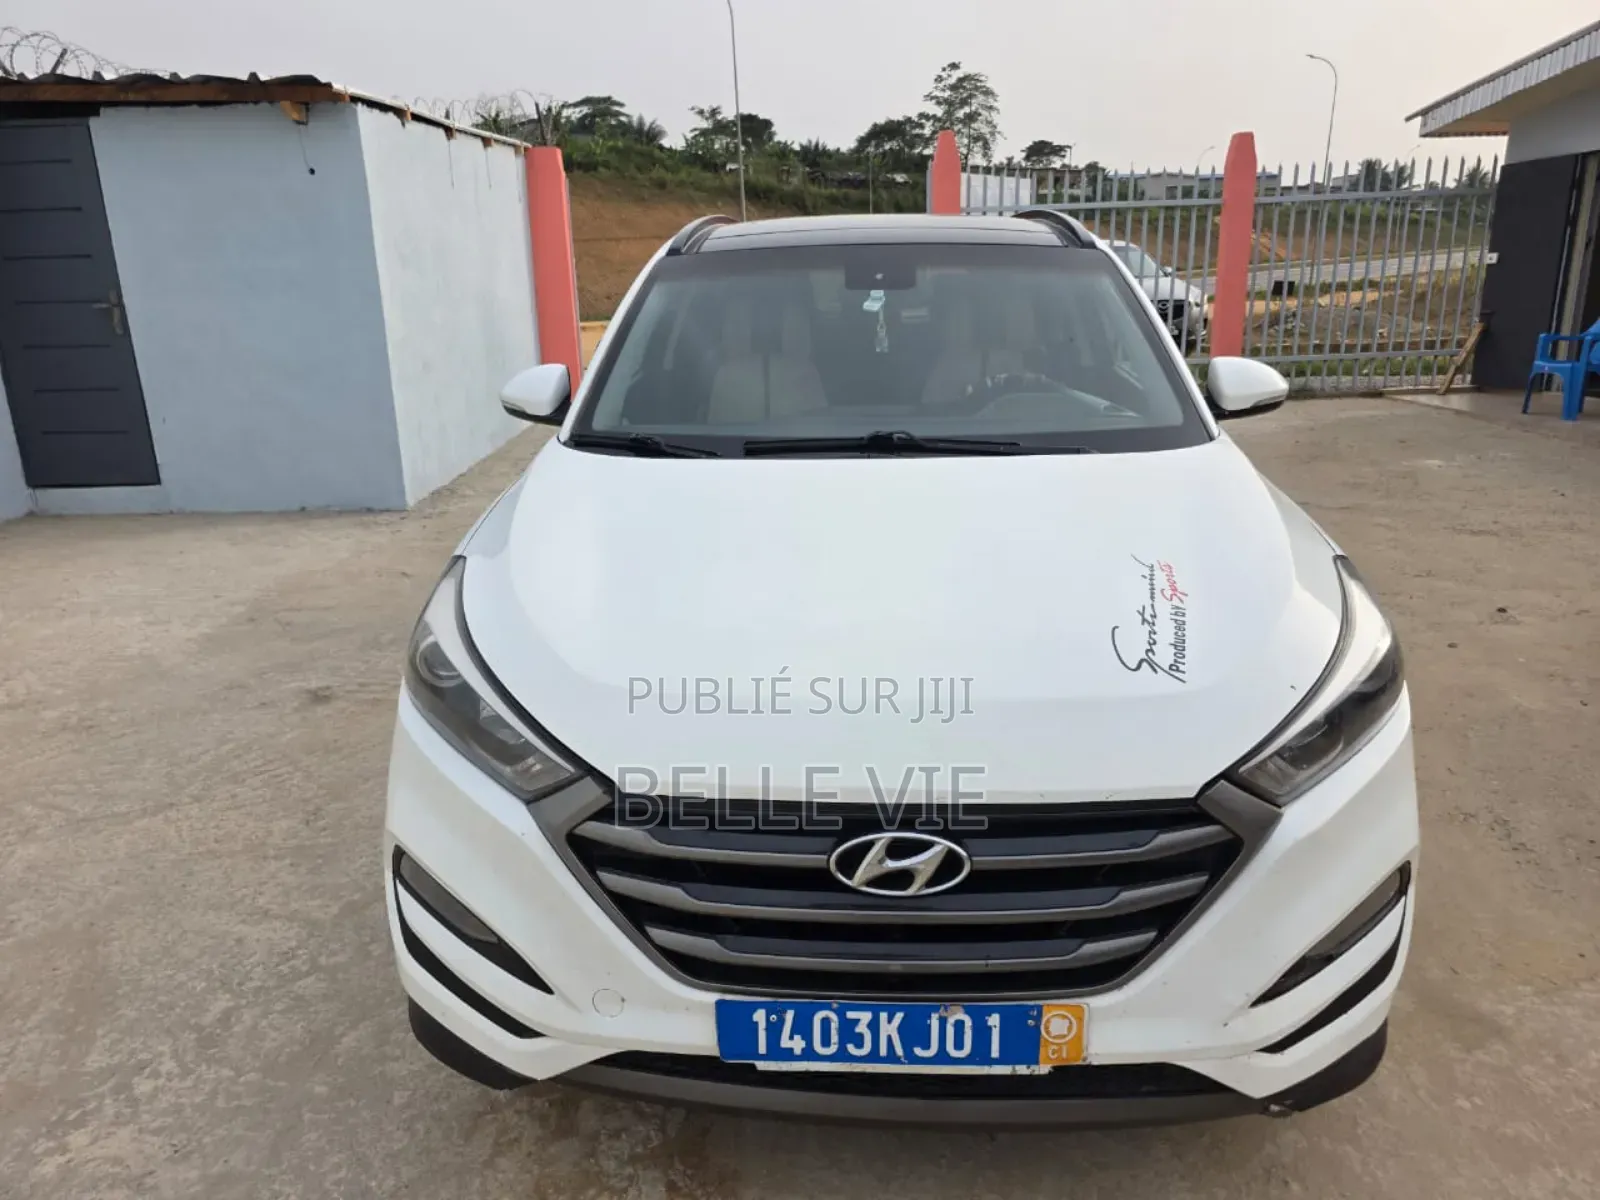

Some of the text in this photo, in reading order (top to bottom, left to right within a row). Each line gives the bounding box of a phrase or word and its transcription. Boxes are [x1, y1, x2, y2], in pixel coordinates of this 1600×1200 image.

[1157, 559, 1188, 604] Sports
[1168, 618, 1187, 675] Produced
[1047, 1045, 1068, 1060] CI
